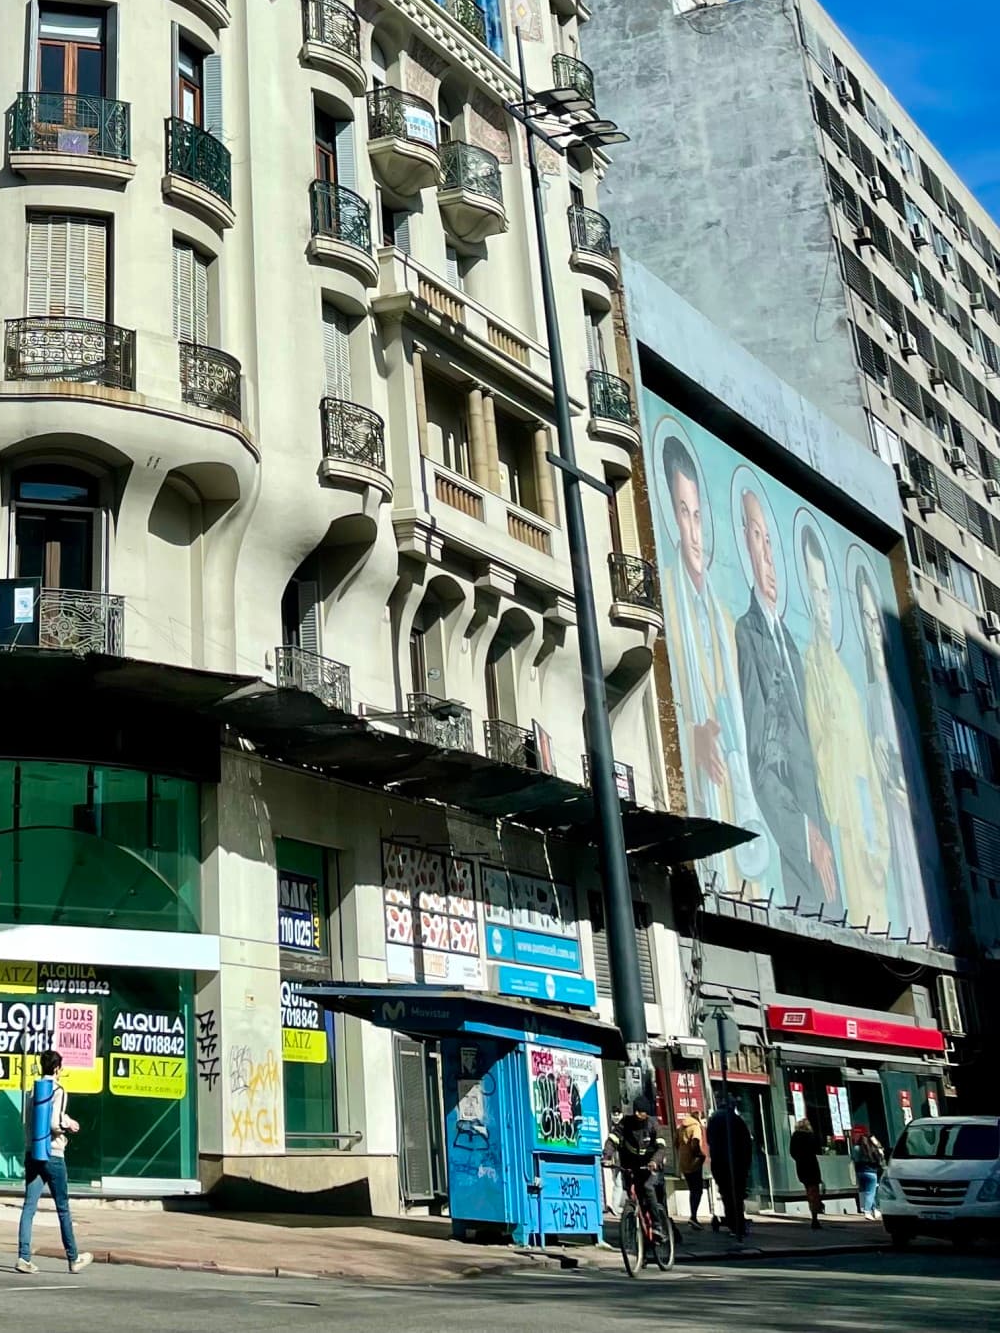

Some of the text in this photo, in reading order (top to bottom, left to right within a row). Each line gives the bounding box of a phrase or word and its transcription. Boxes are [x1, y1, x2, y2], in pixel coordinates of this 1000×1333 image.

[295, 919, 311, 947] 025
[40, 964, 97, 979] ALQUILA
[59, 1008, 93, 1021] TODXS
[113, 1013, 184, 1034] ALQUILA
[59, 1021, 93, 1031] SOMOS
[58, 1032, 92, 1050] ANIMALES
[122, 1033, 143, 1052] 097
[284, 1030, 311, 1050] KATZ
[133, 1059, 183, 1079] KATZ
